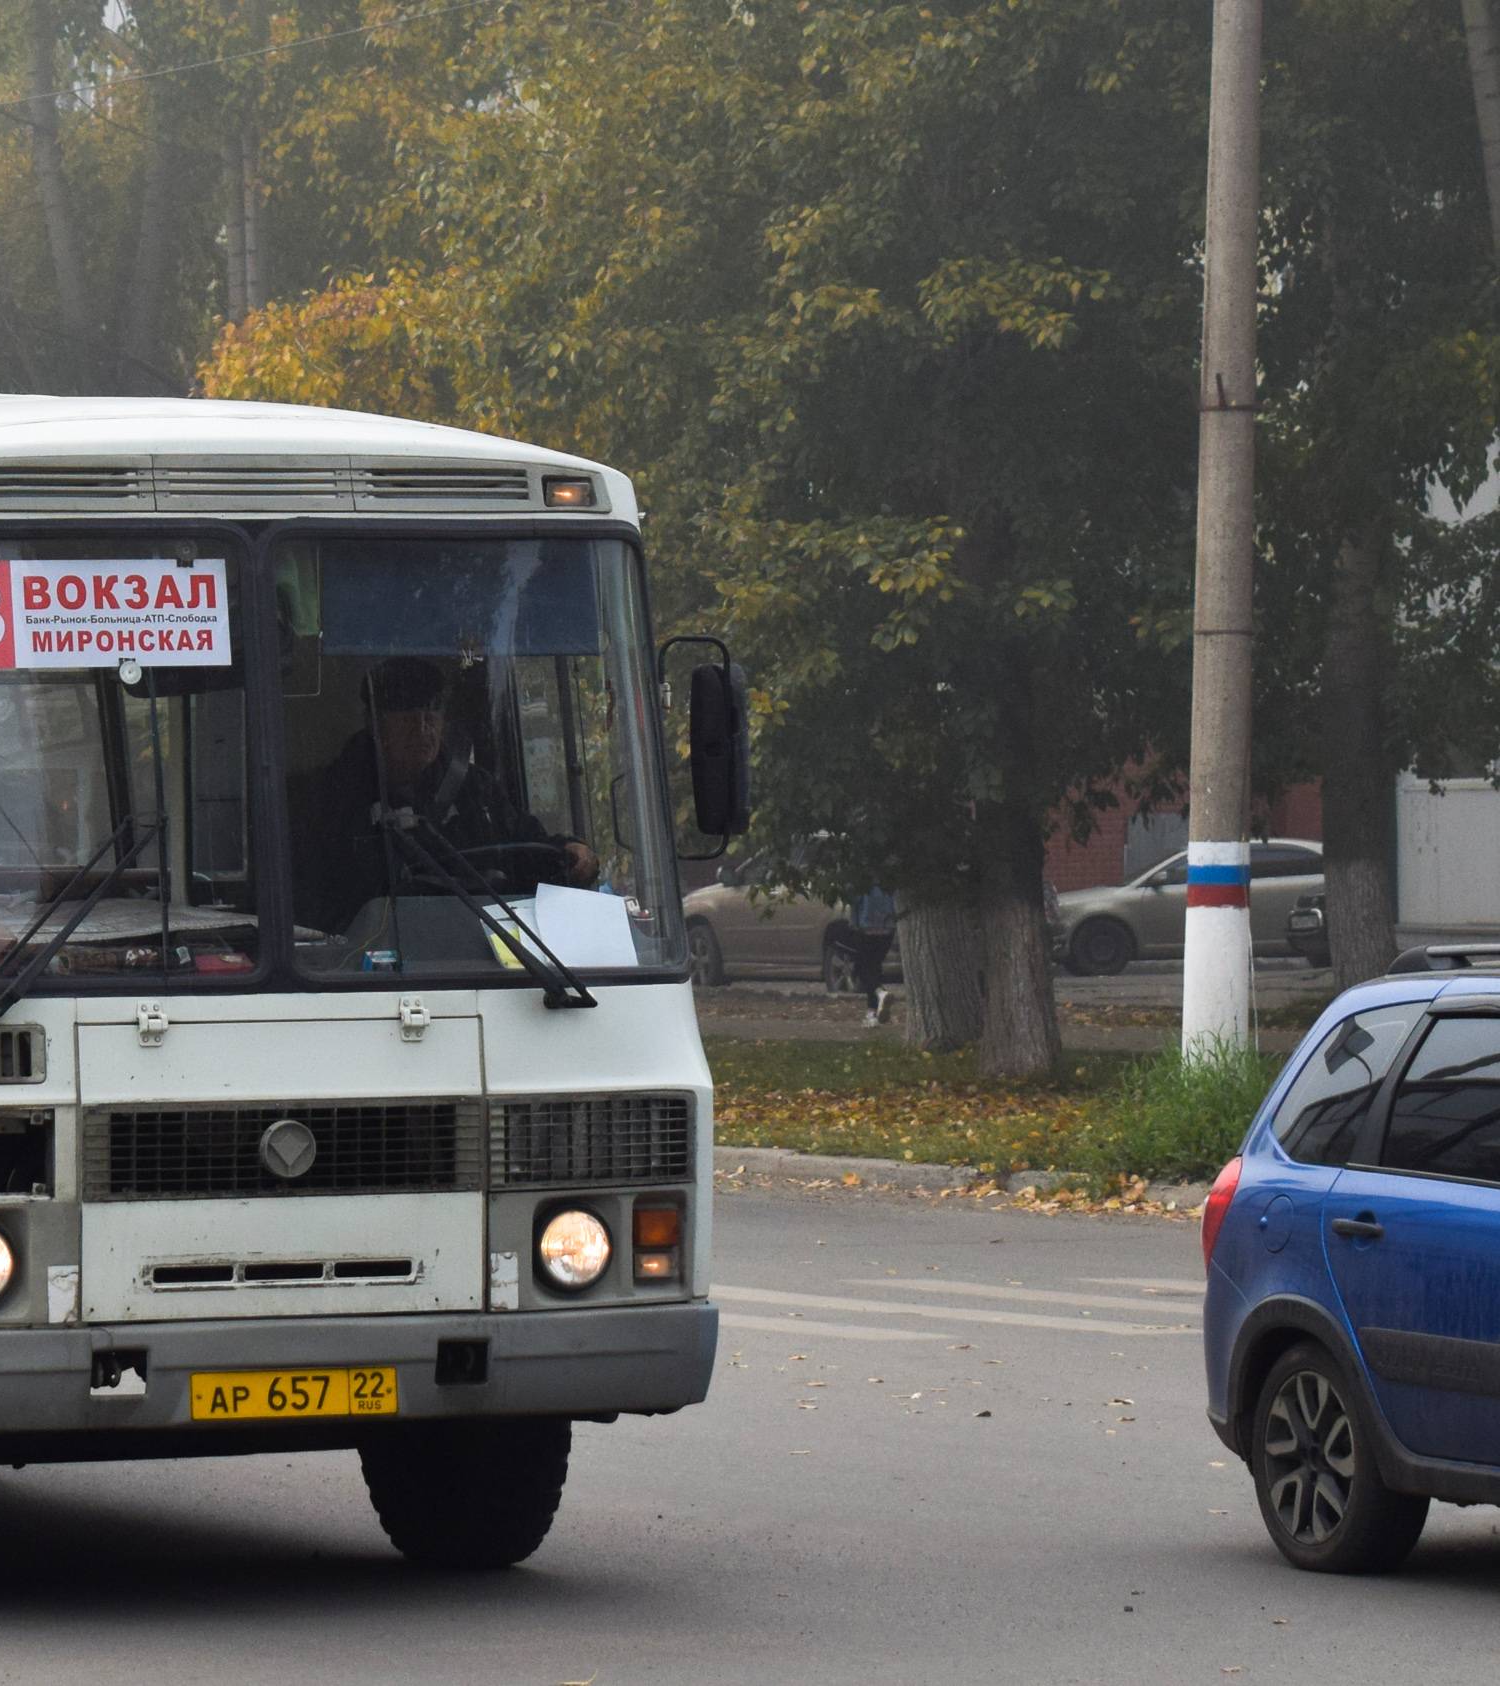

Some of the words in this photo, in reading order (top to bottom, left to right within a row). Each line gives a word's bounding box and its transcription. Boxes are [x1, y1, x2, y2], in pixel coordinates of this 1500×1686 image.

[23, 575, 217, 610] ВОКЗАЛ
[32, 630, 214, 653] МИРОНСКАЯ
[210, 1386, 250, 1414] АР
[267, 1375, 331, 1412] 657
[353, 1371, 386, 1399] 22
[357, 1400, 382, 1411] RUS
